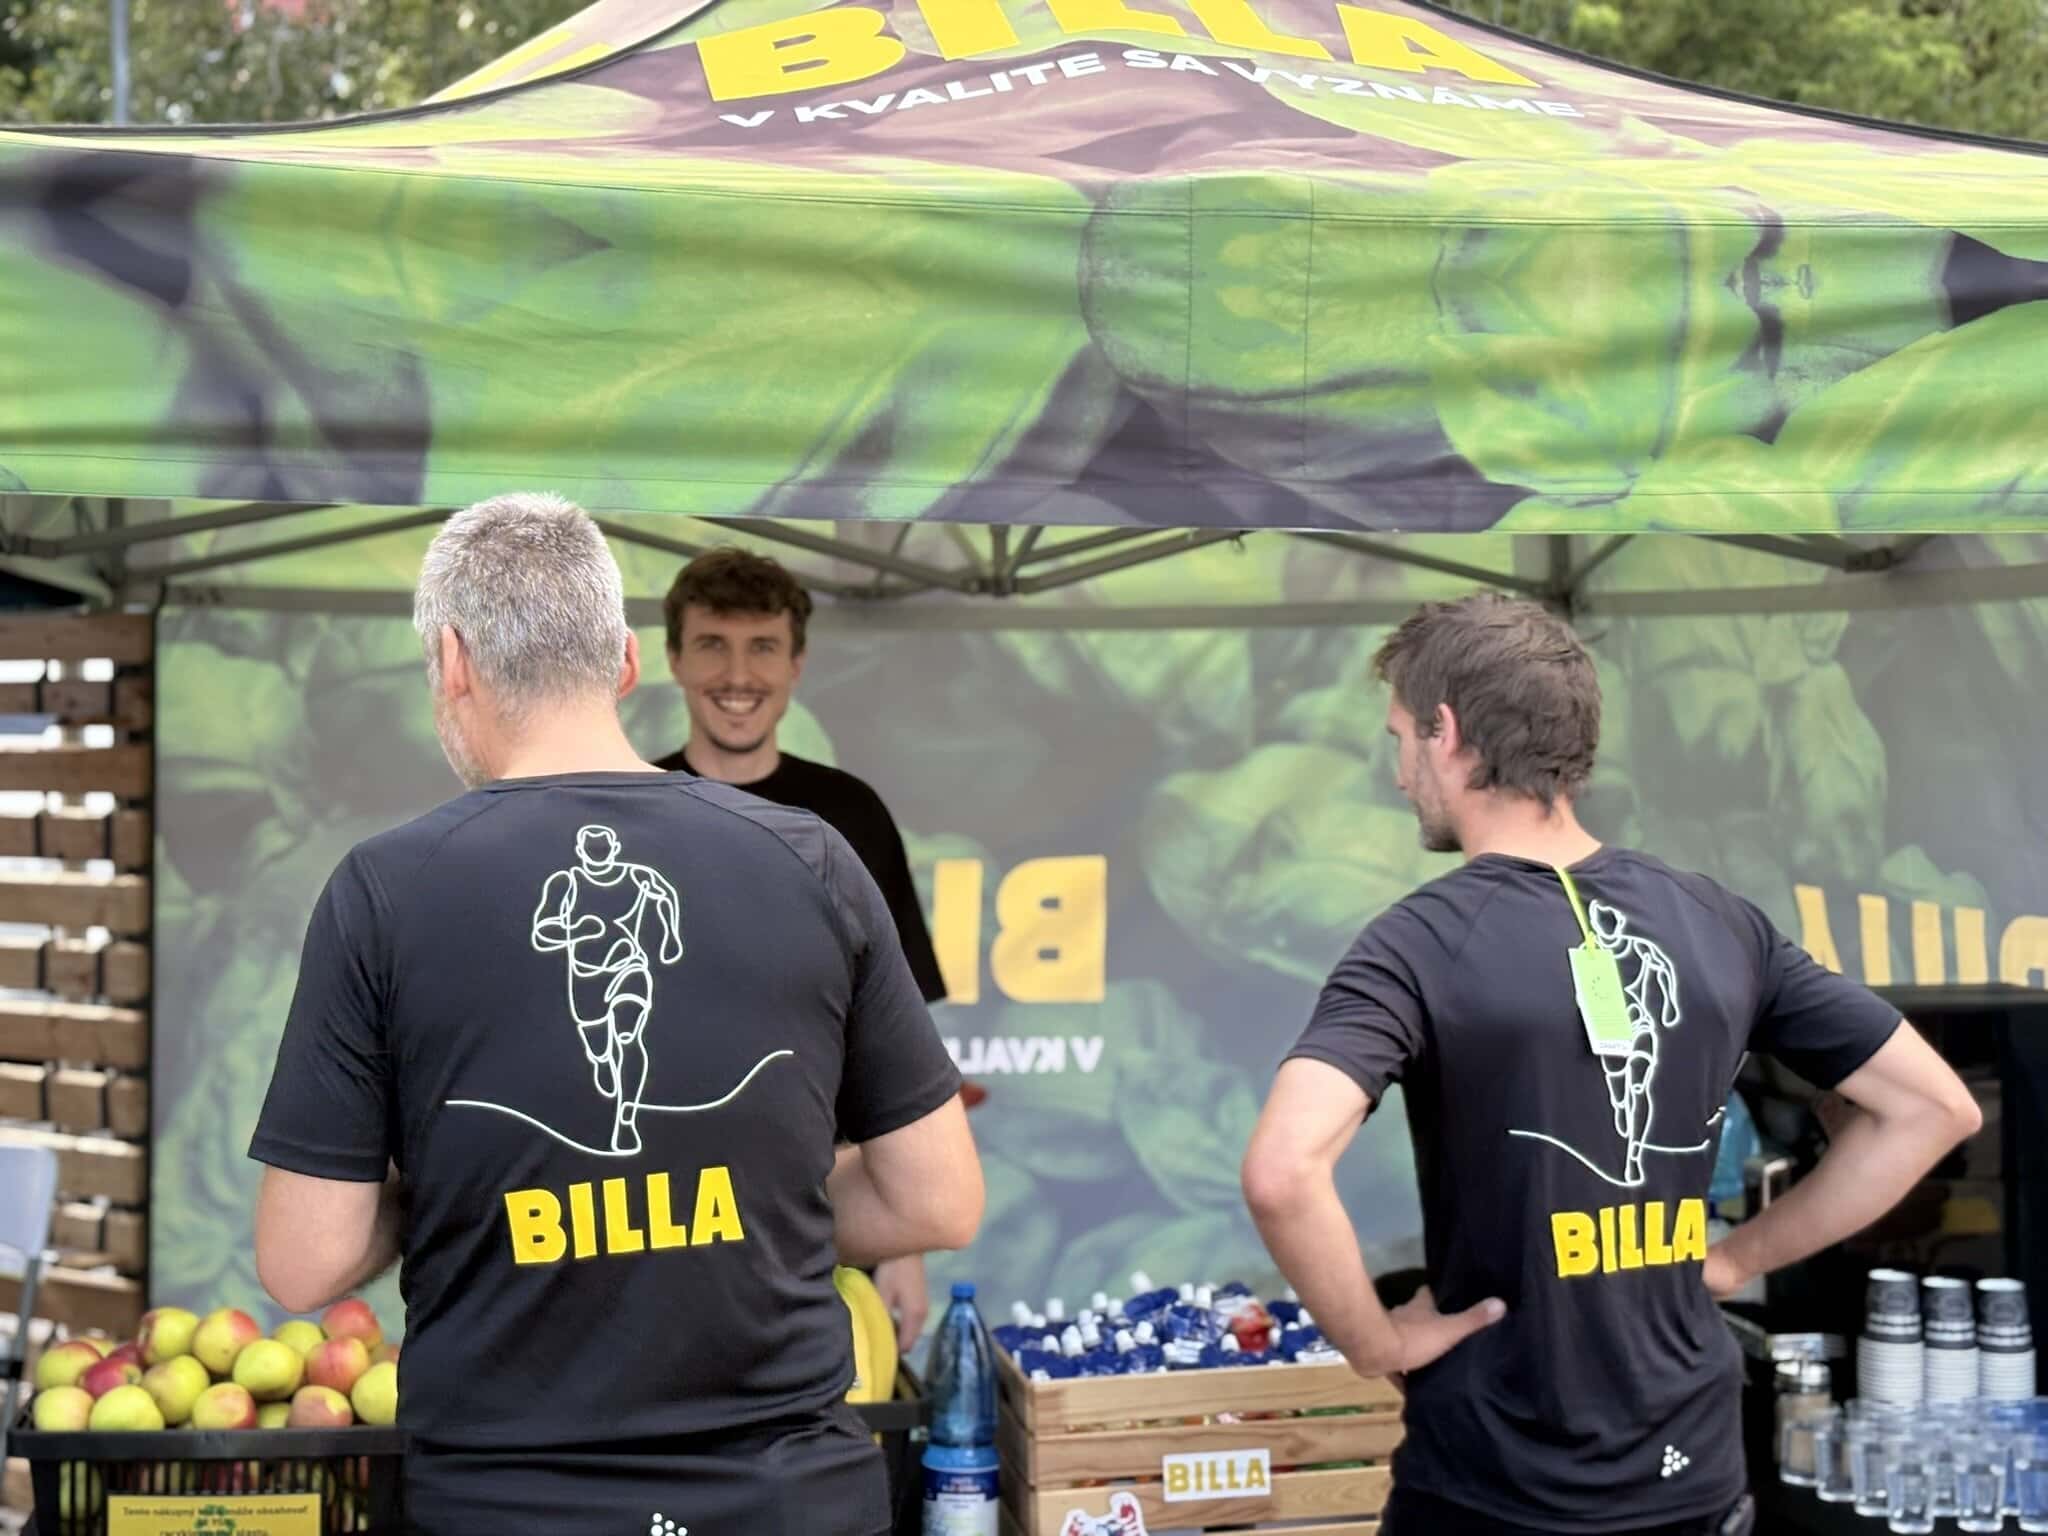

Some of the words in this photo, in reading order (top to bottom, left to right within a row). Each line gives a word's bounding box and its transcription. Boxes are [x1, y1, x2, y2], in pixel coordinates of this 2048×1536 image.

[719, 110, 775, 127] V
[794, 53, 1105, 122] KVALITE
[1122, 49, 1219, 76] SA
[504, 1166, 745, 1264] BILLA
[1551, 1198, 1707, 1278] BILLA
[1167, 1457, 1265, 1493] BILLA
